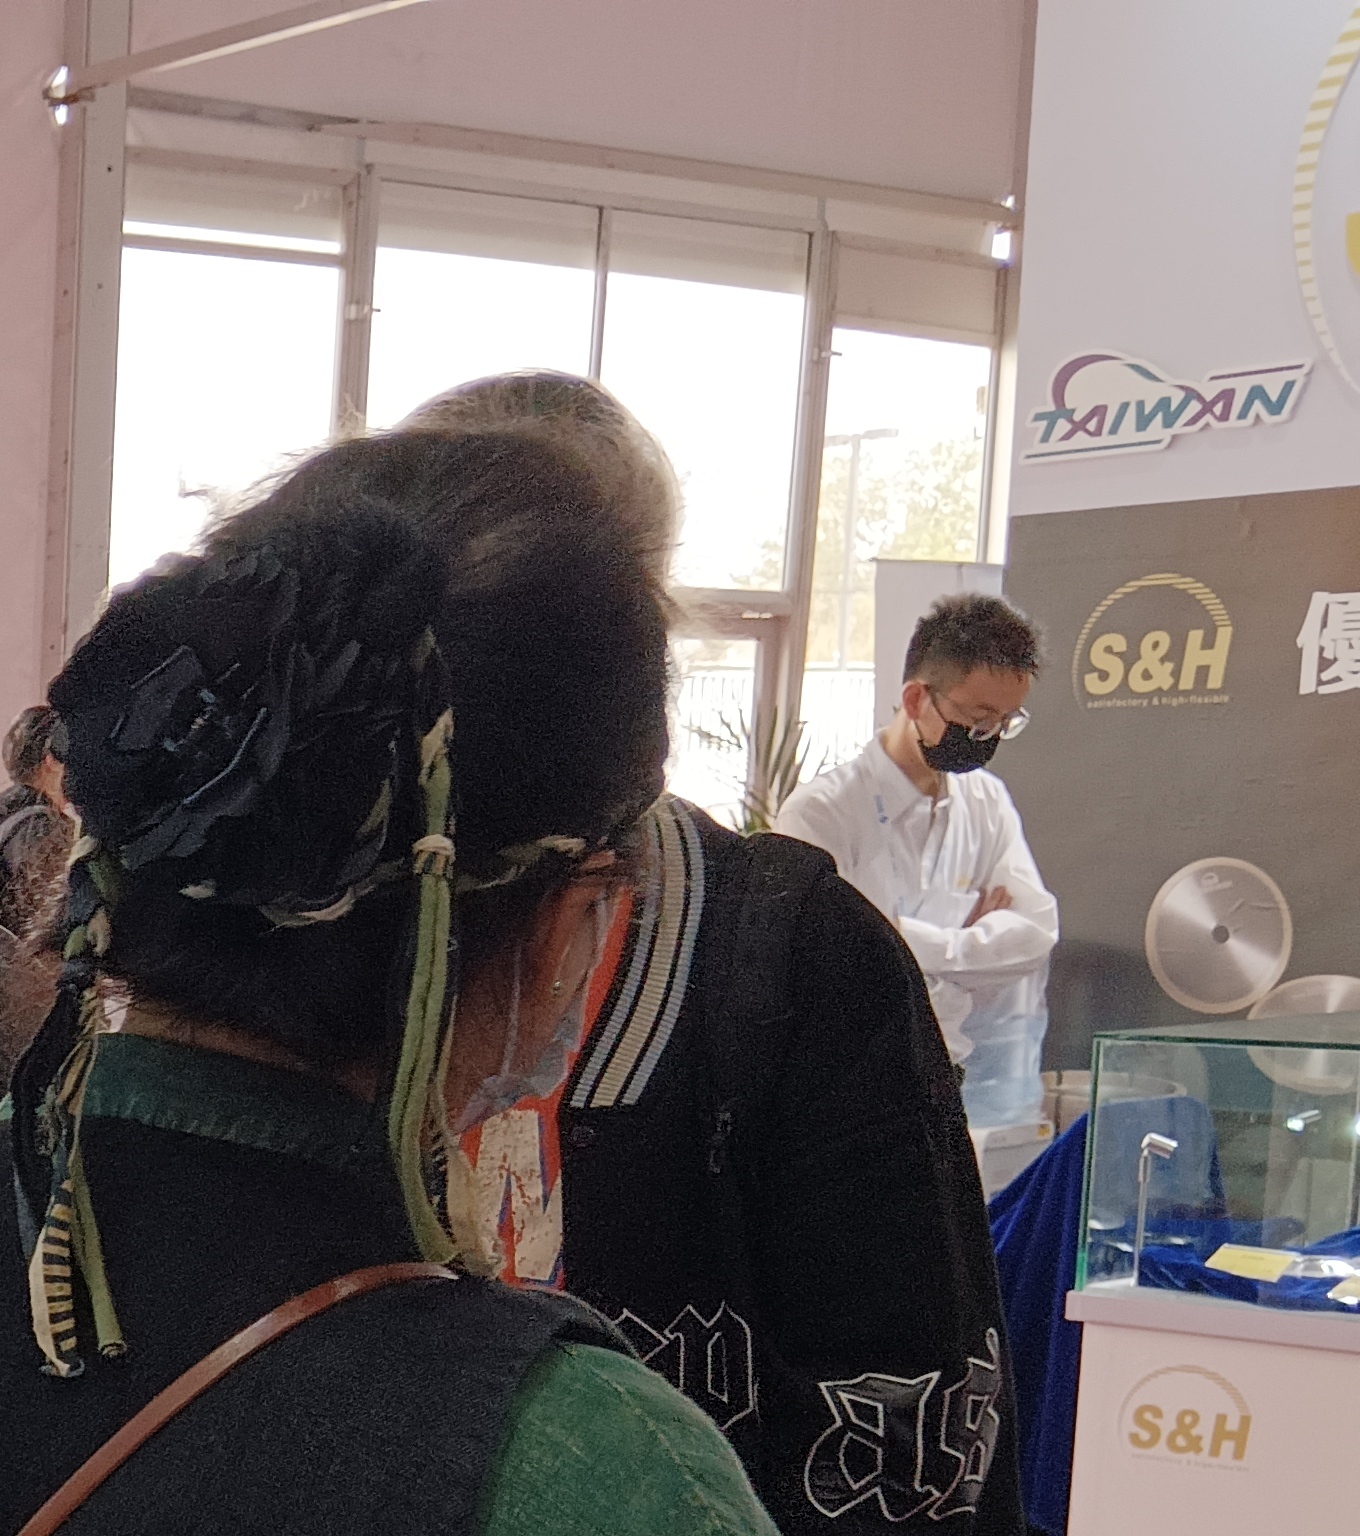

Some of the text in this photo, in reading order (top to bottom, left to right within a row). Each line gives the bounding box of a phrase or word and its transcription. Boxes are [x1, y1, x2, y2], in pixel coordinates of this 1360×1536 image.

[1032, 378, 1298, 444] TAIWAN
[1084, 626, 1233, 696] S&H
[1128, 1403, 1253, 1462] S&H
